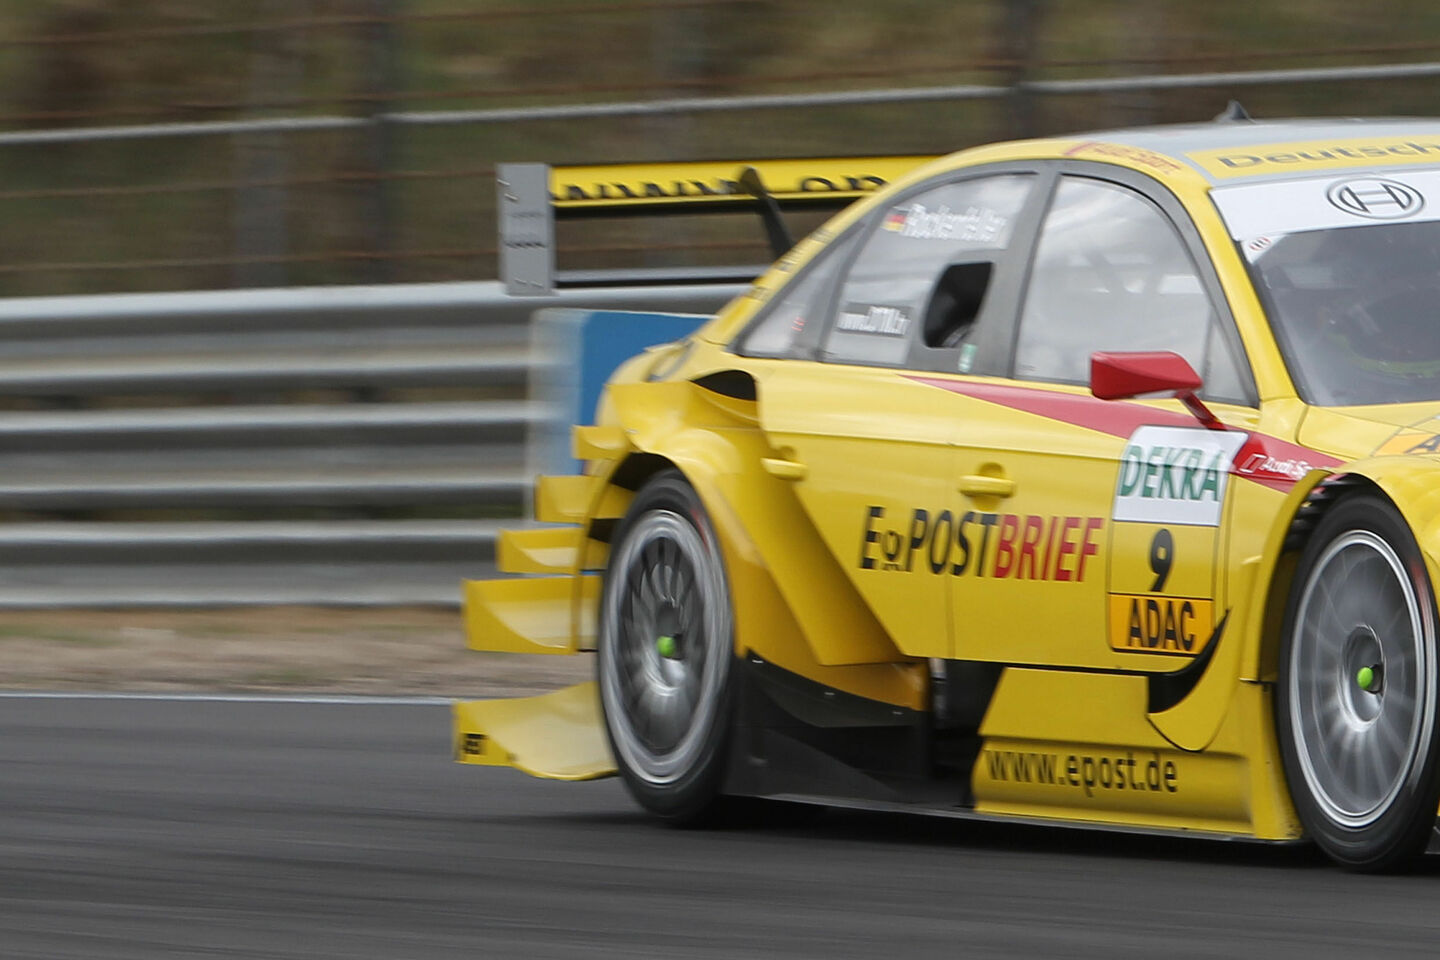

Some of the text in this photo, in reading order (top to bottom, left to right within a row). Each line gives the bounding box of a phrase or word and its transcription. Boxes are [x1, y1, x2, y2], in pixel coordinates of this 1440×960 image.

[1119, 444, 1221, 503] DEKRA
[905, 508, 1105, 582] POSTBRIEF
[1148, 528, 1175, 592] 9
[1126, 598, 1197, 652] ADAC
[985, 750, 1179, 798] www.epost.de
